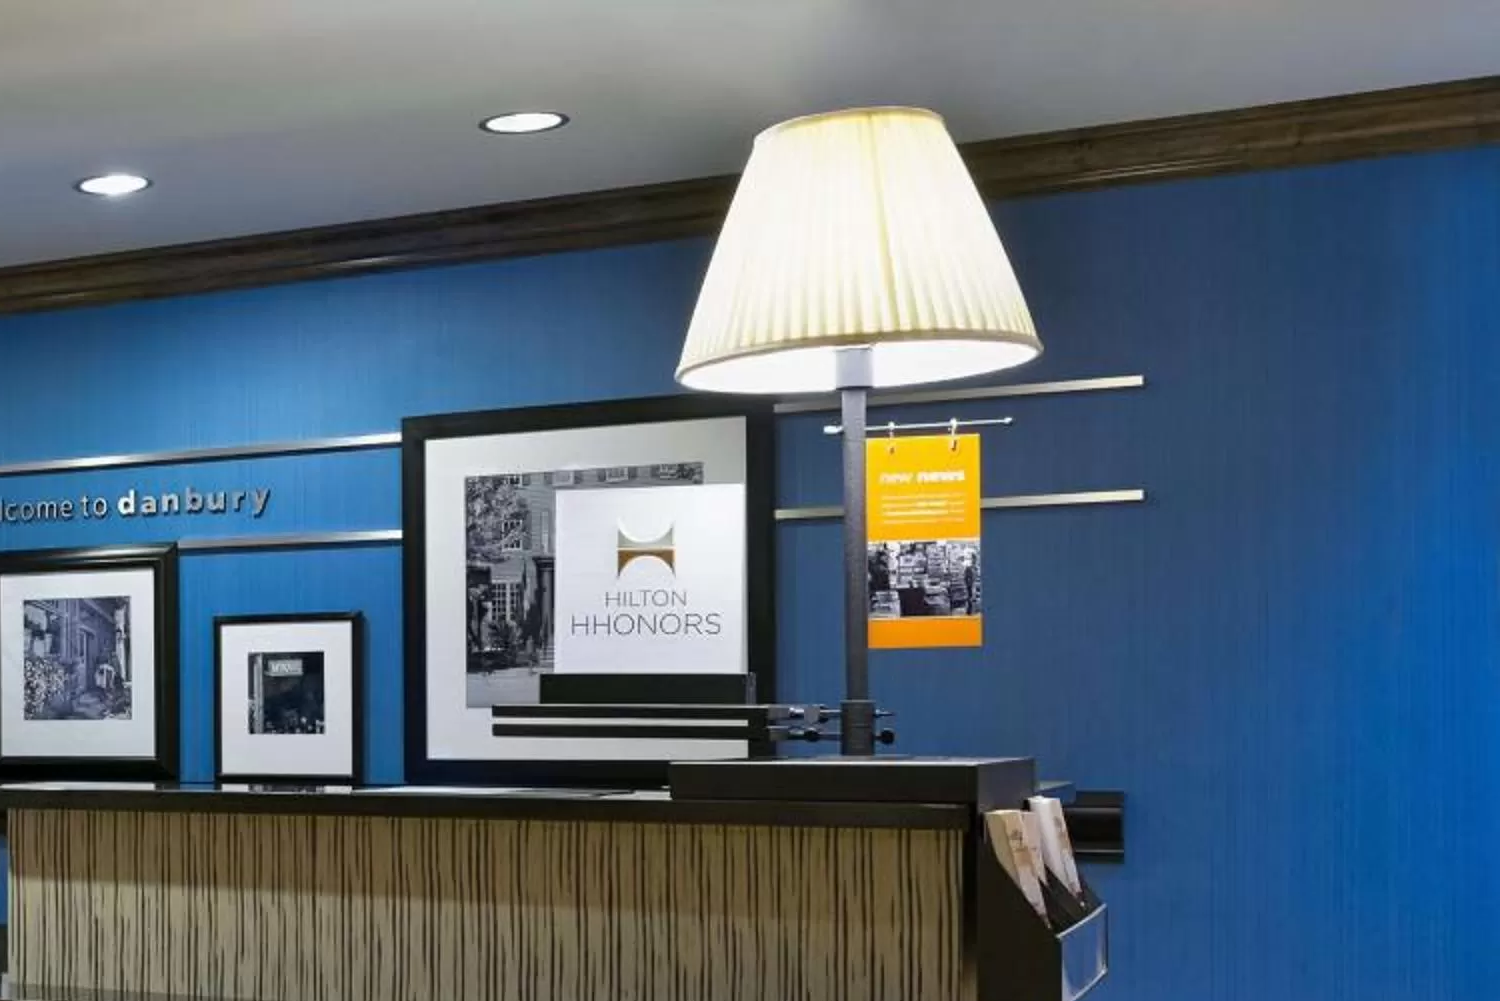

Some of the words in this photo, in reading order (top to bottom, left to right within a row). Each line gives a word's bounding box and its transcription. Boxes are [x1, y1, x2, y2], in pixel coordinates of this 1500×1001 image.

[80, 495, 107, 517] to
[117, 488, 270, 518] danbury
[605, 589, 687, 607] HILTON
[571, 613, 721, 635] HHONORS
